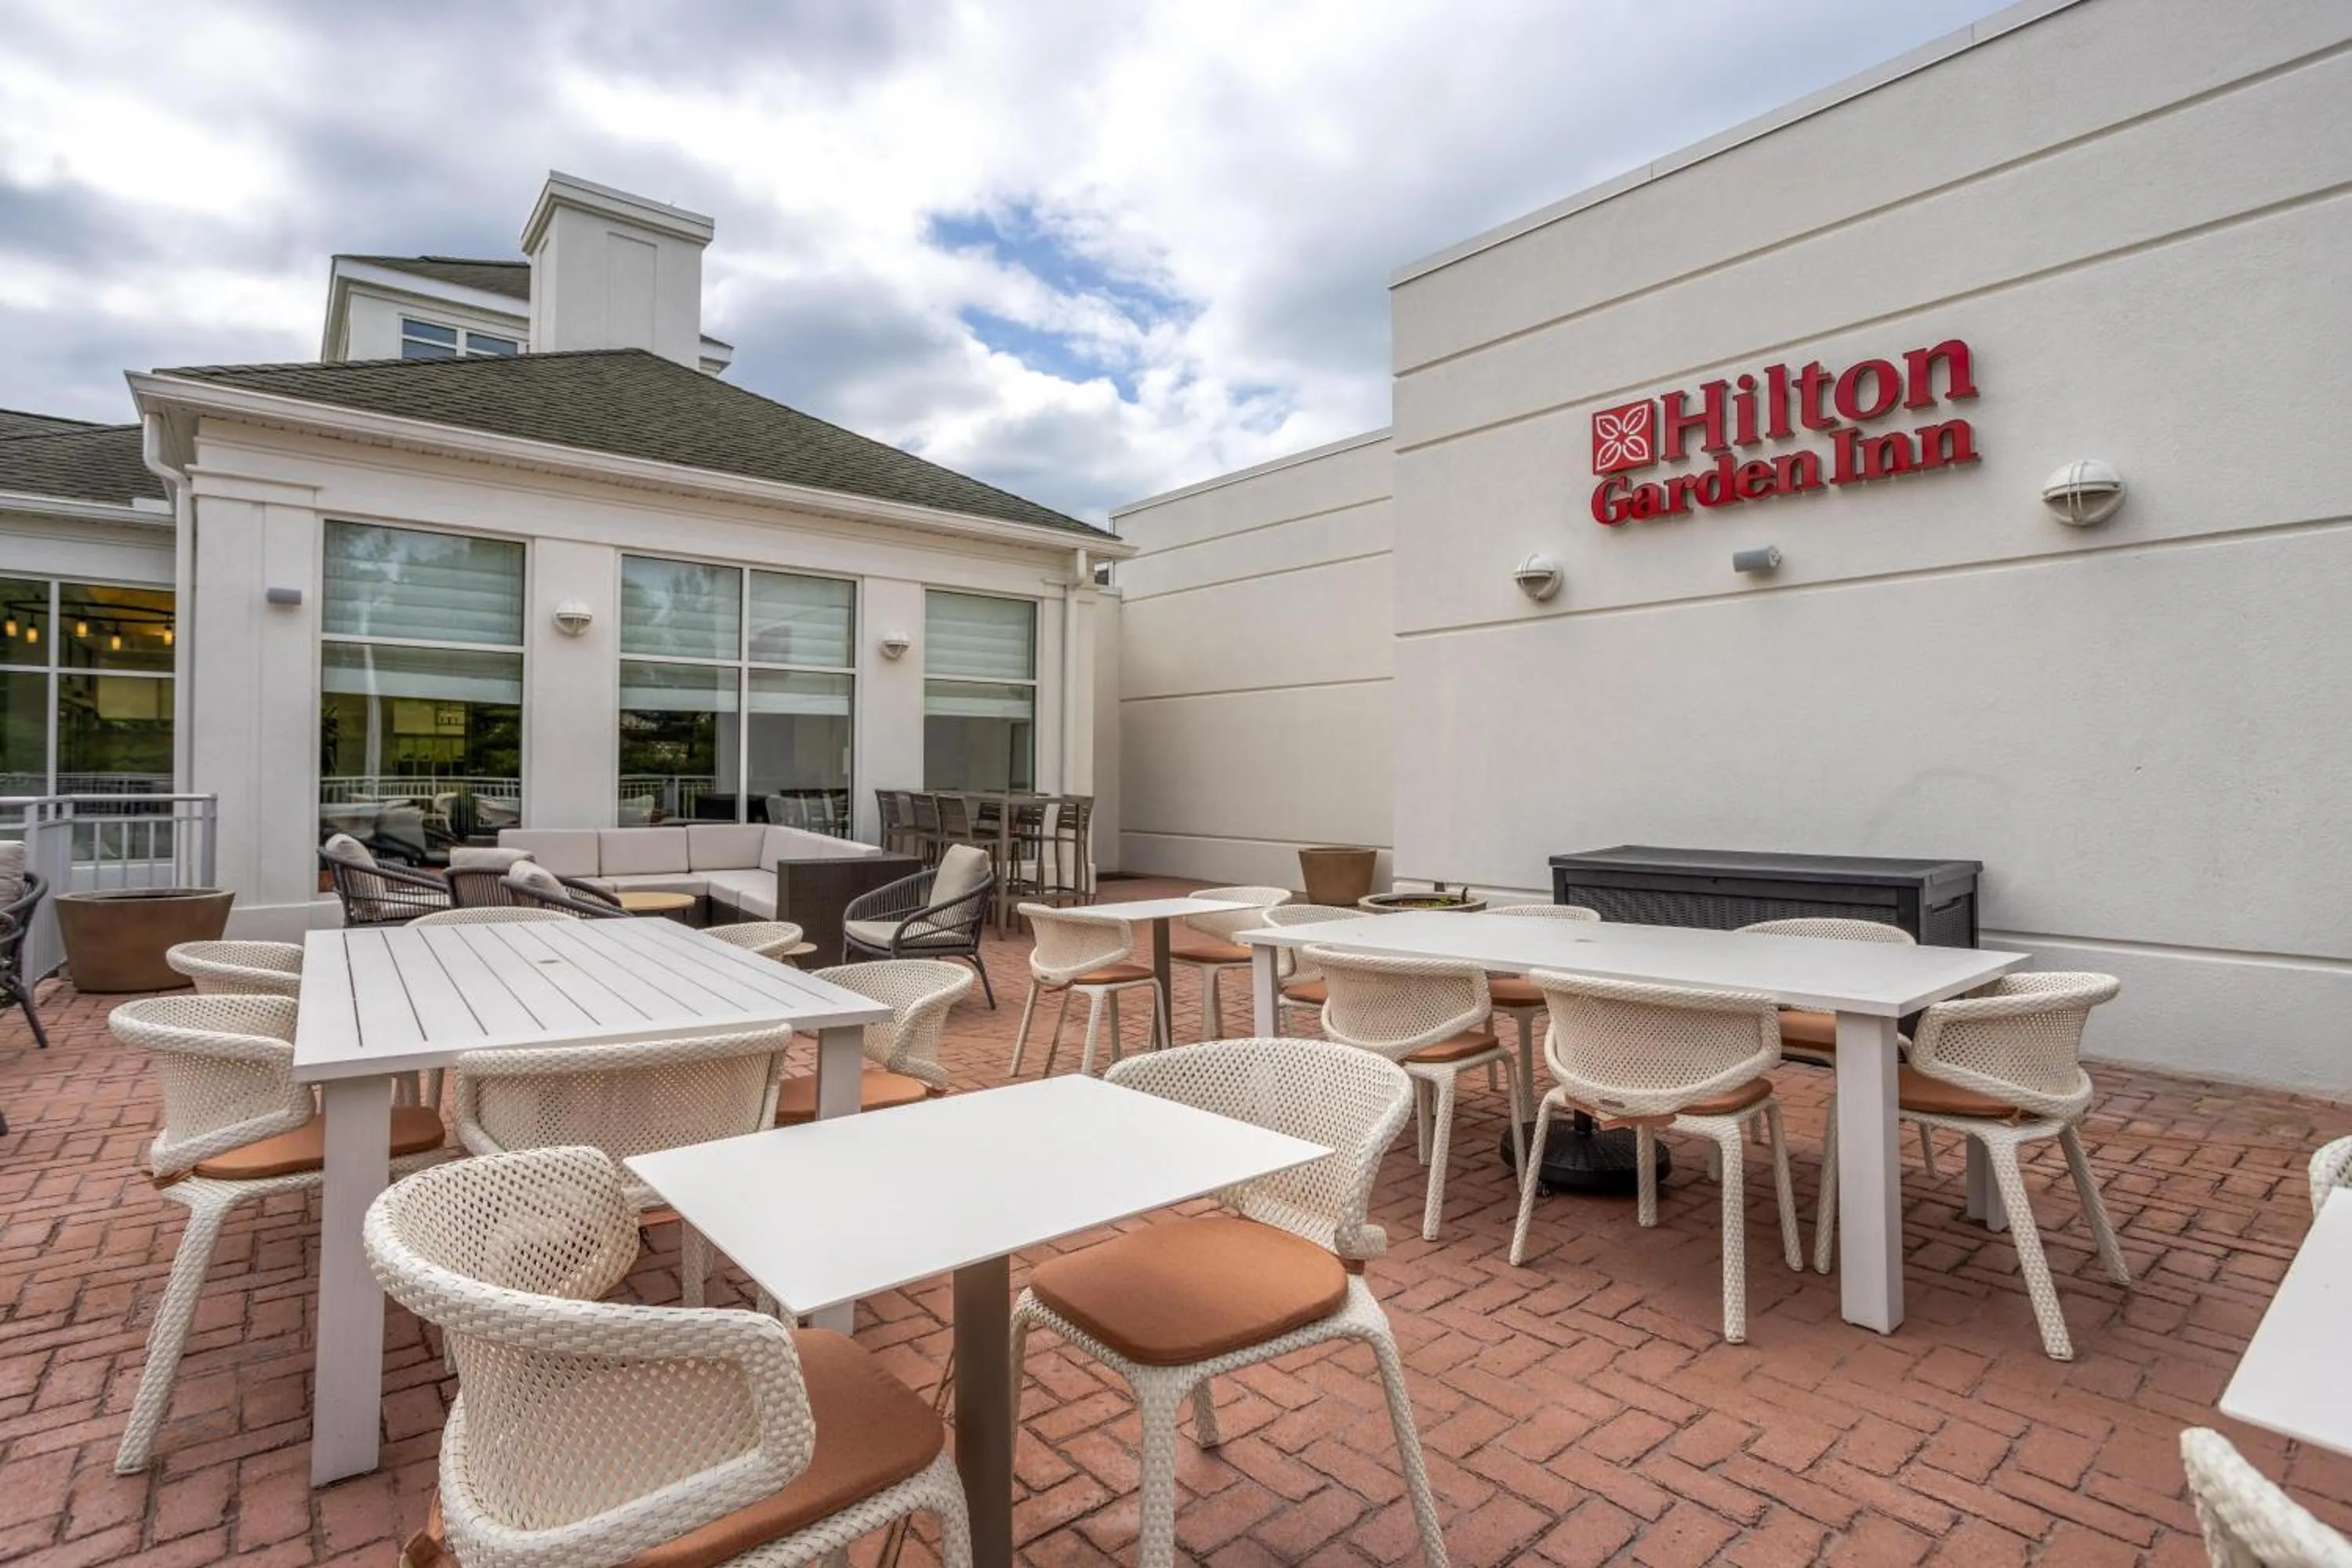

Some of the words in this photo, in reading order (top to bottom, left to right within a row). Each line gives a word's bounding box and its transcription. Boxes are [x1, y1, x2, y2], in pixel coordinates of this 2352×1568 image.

[1660, 339, 1980, 463] Hilton
[1591, 448, 1828, 527] Garden
[1826, 418, 1981, 485] Inn
